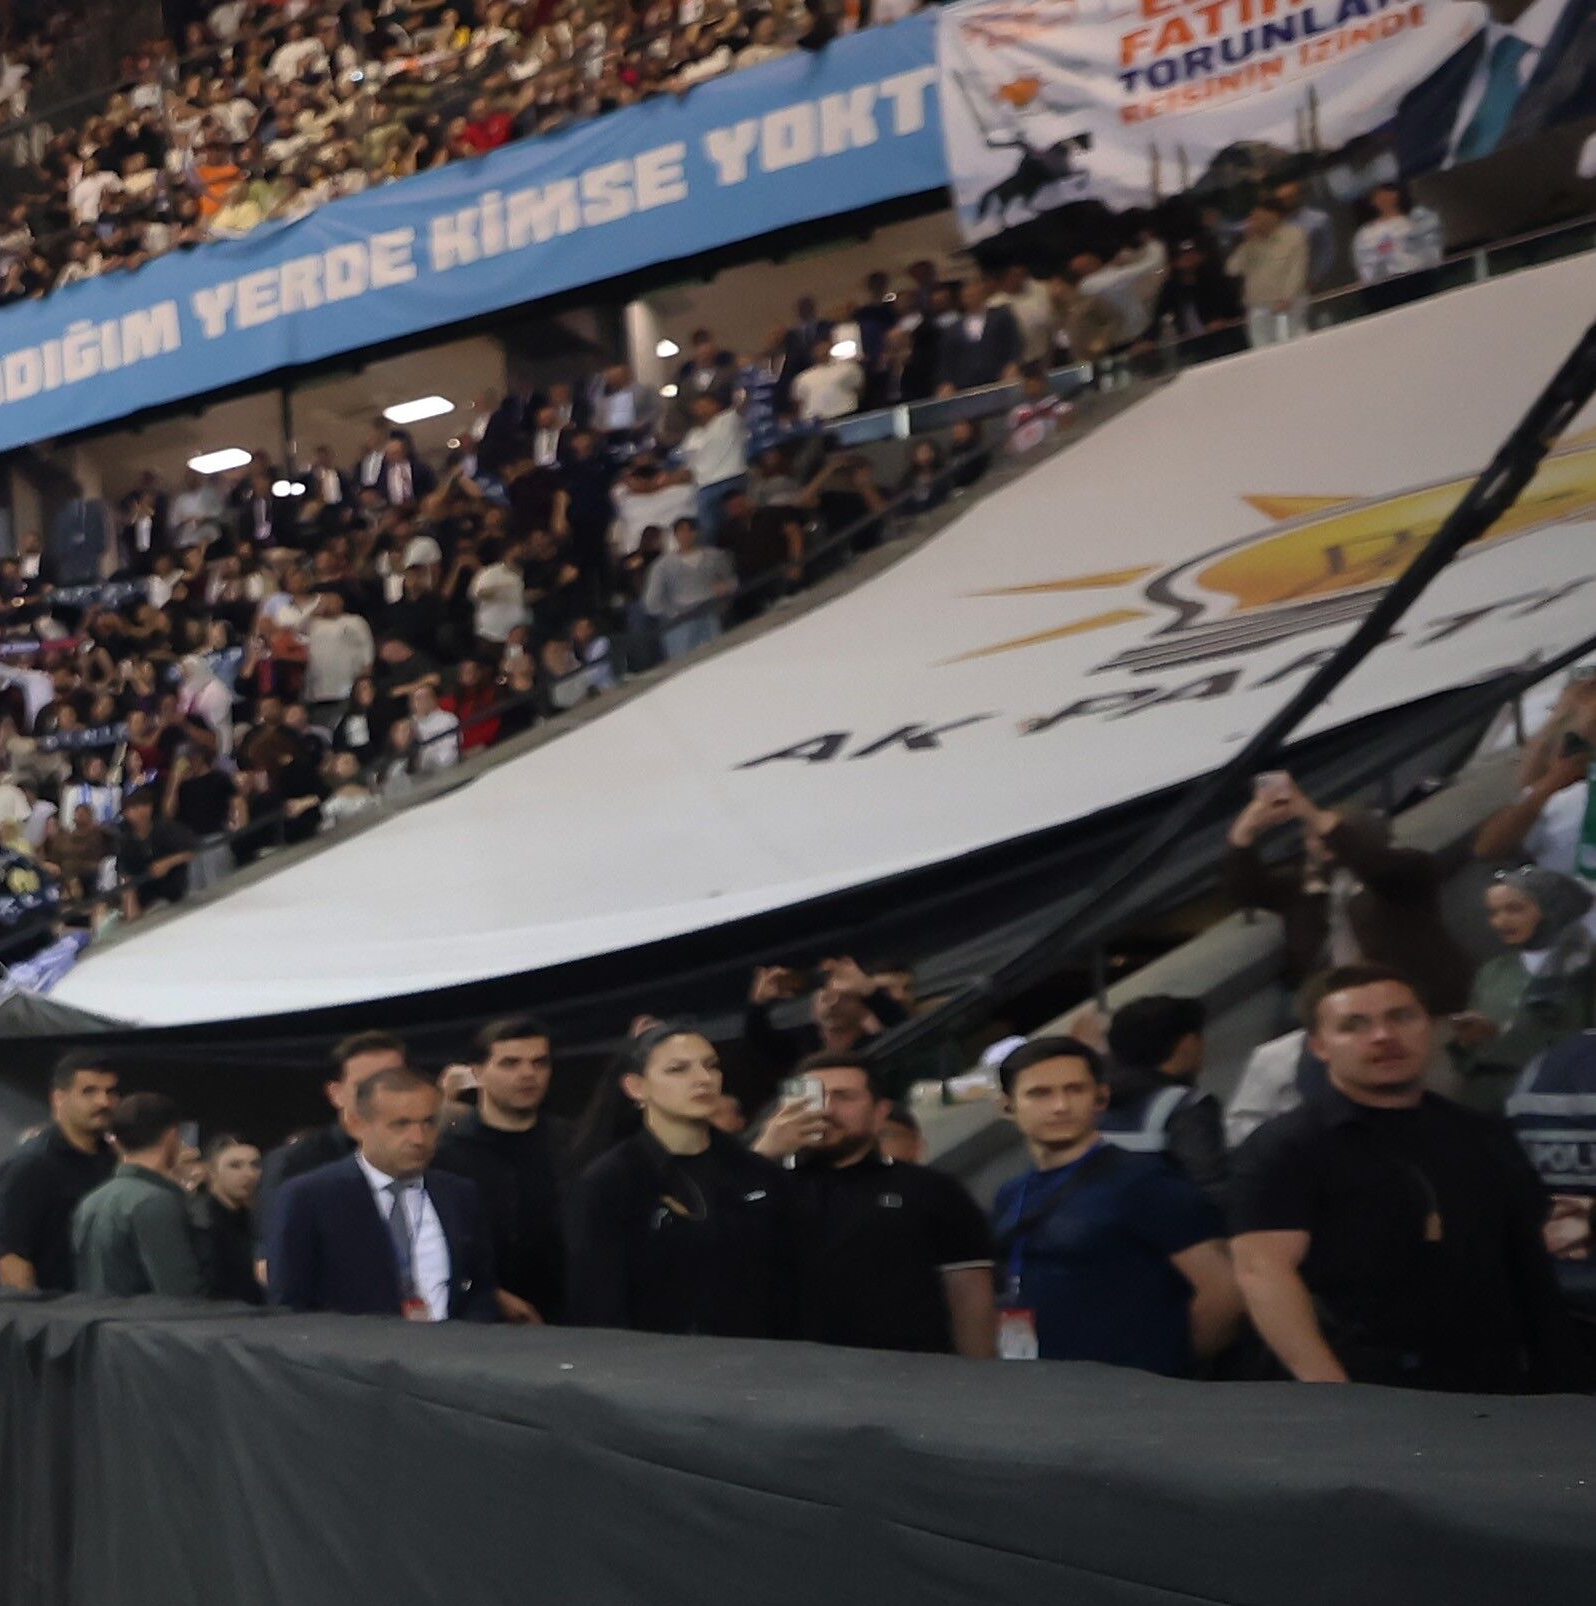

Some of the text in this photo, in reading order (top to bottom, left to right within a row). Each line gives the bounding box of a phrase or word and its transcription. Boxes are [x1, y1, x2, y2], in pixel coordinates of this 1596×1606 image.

[1119, 0, 1390, 92] TORUNLA
[192, 228, 417, 338] YERDE
[430, 141, 688, 273] KİMSE
[704, 66, 938, 186] YOKT
